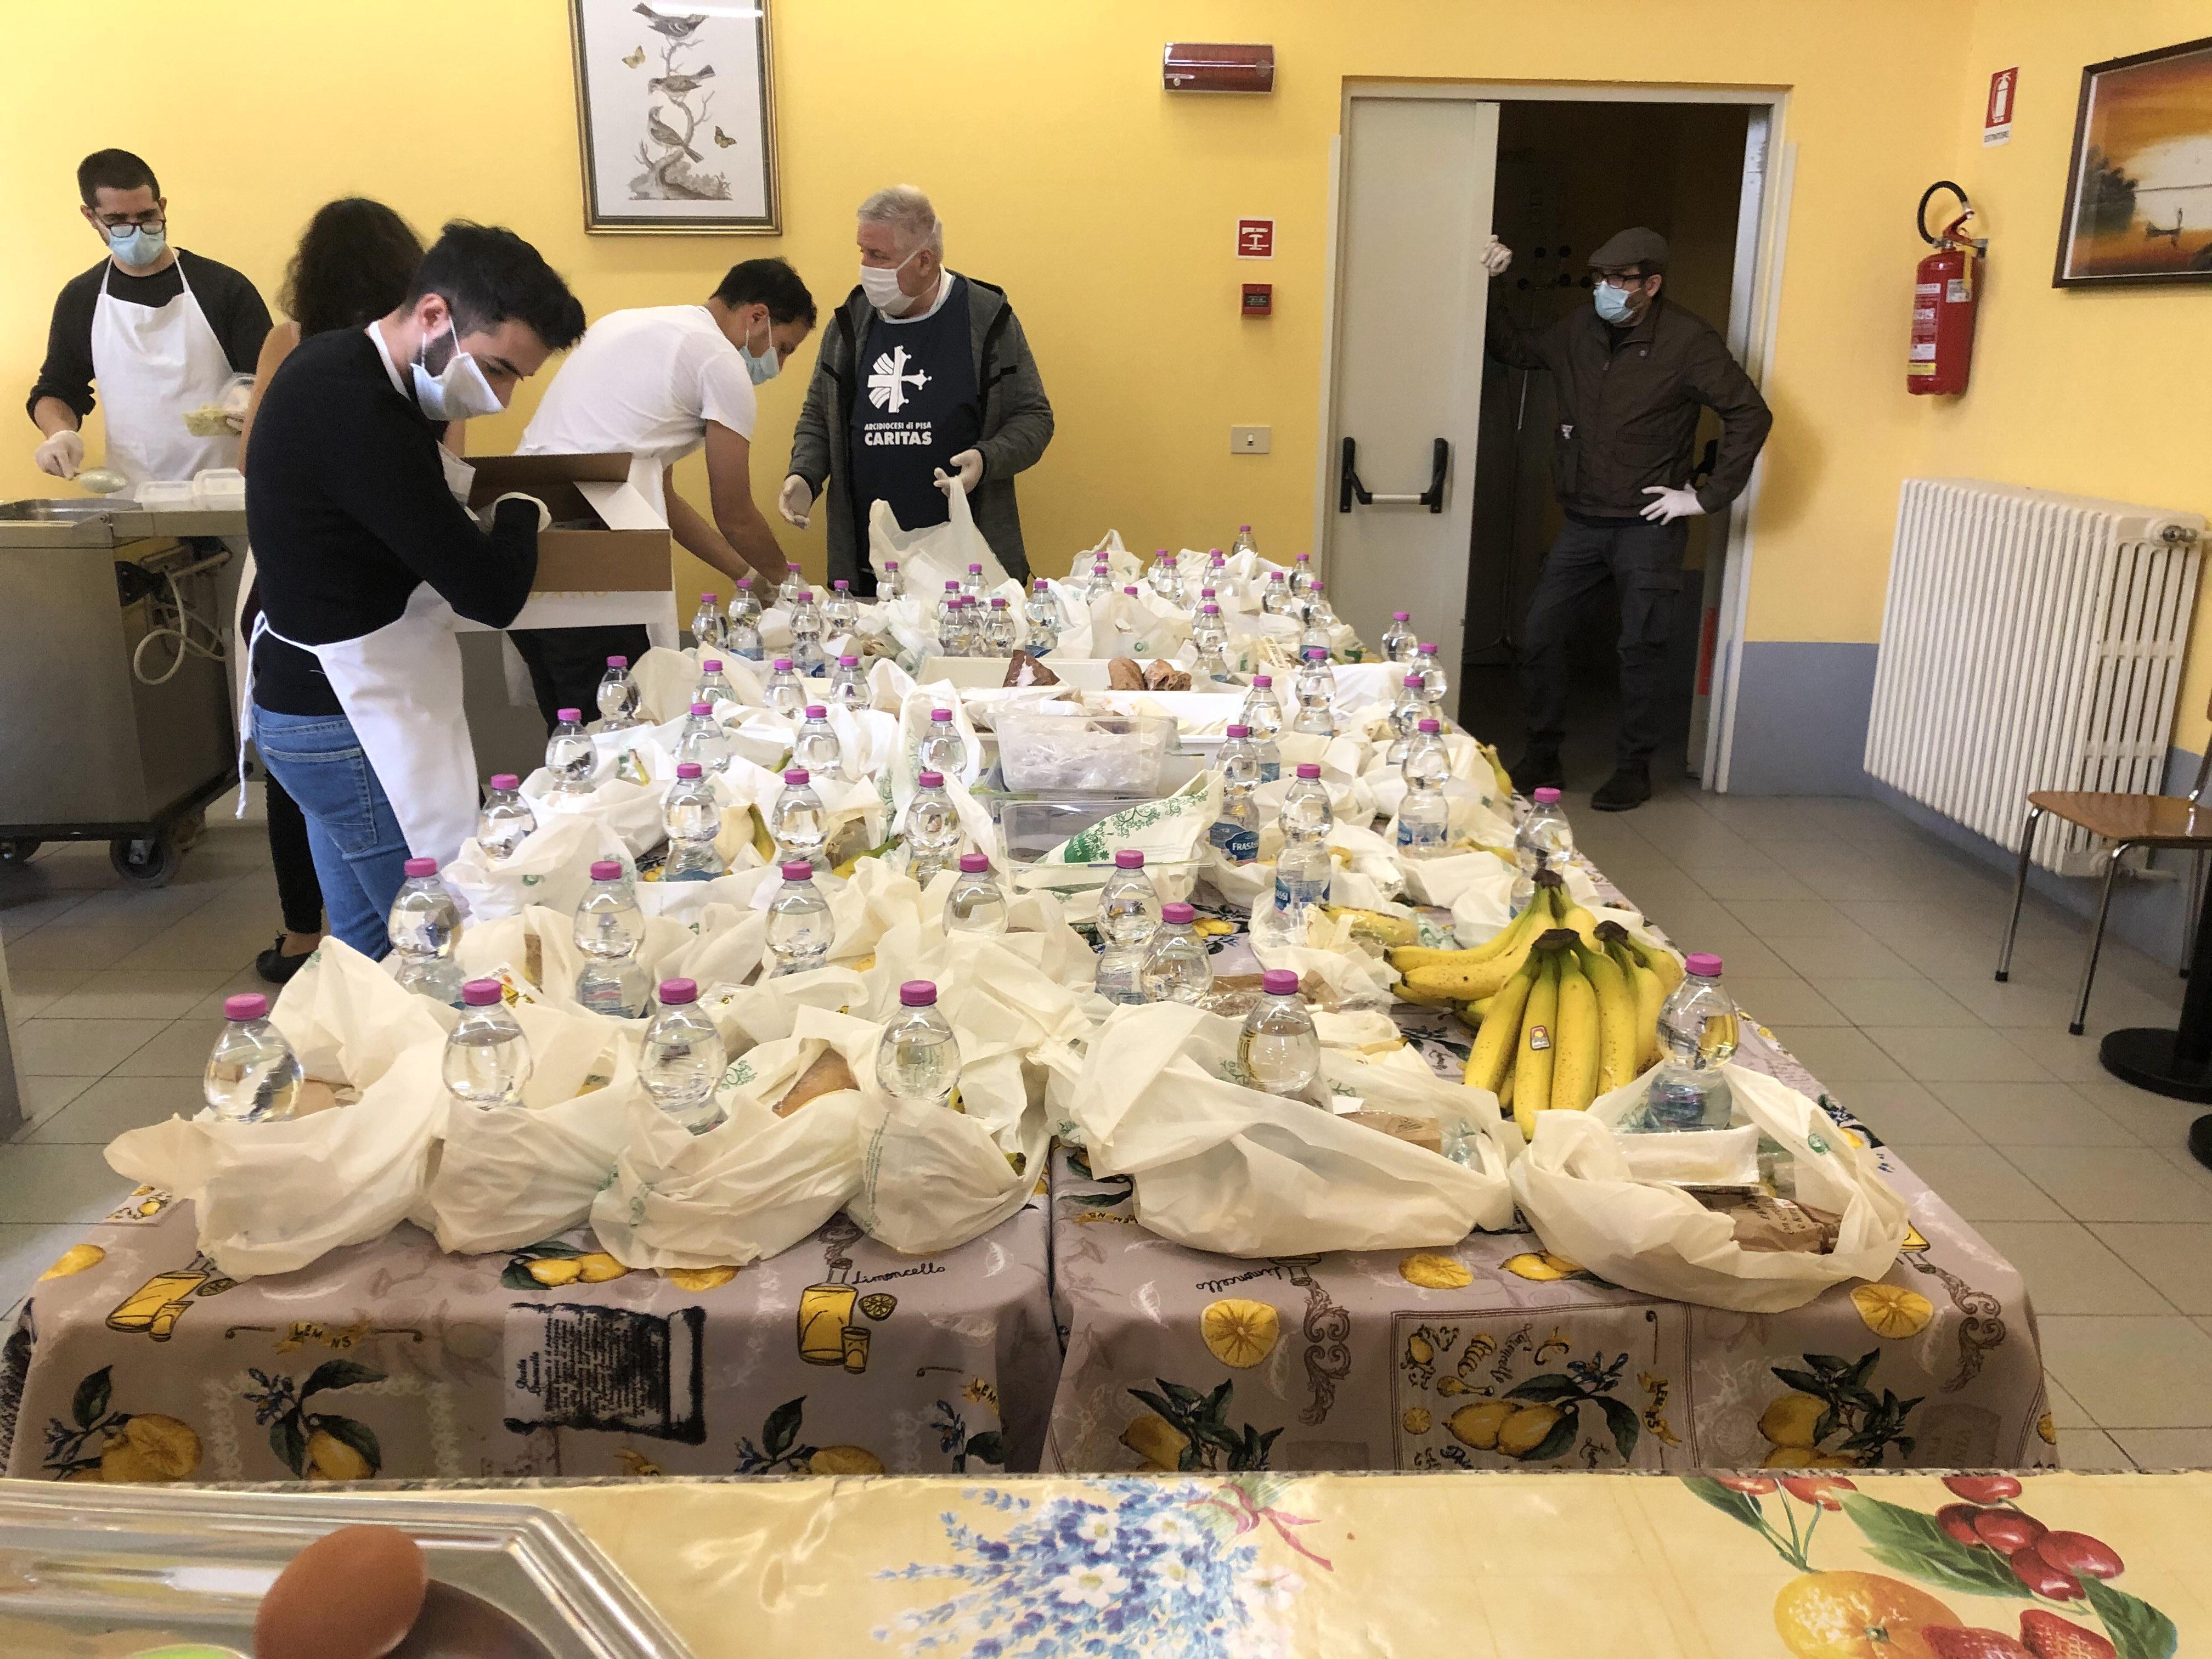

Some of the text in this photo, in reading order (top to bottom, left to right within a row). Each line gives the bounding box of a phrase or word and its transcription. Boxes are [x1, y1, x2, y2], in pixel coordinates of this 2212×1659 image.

[864, 422, 904, 431] ARCIDIOCESI
[915, 421, 932, 430] PISA
[864, 431, 933, 446] CARITAS
[851, 1261, 946, 1285] Limoncello
[1195, 1266, 1282, 1294] Limoncello
[1490, 1323, 1533, 1383] Limoncello
